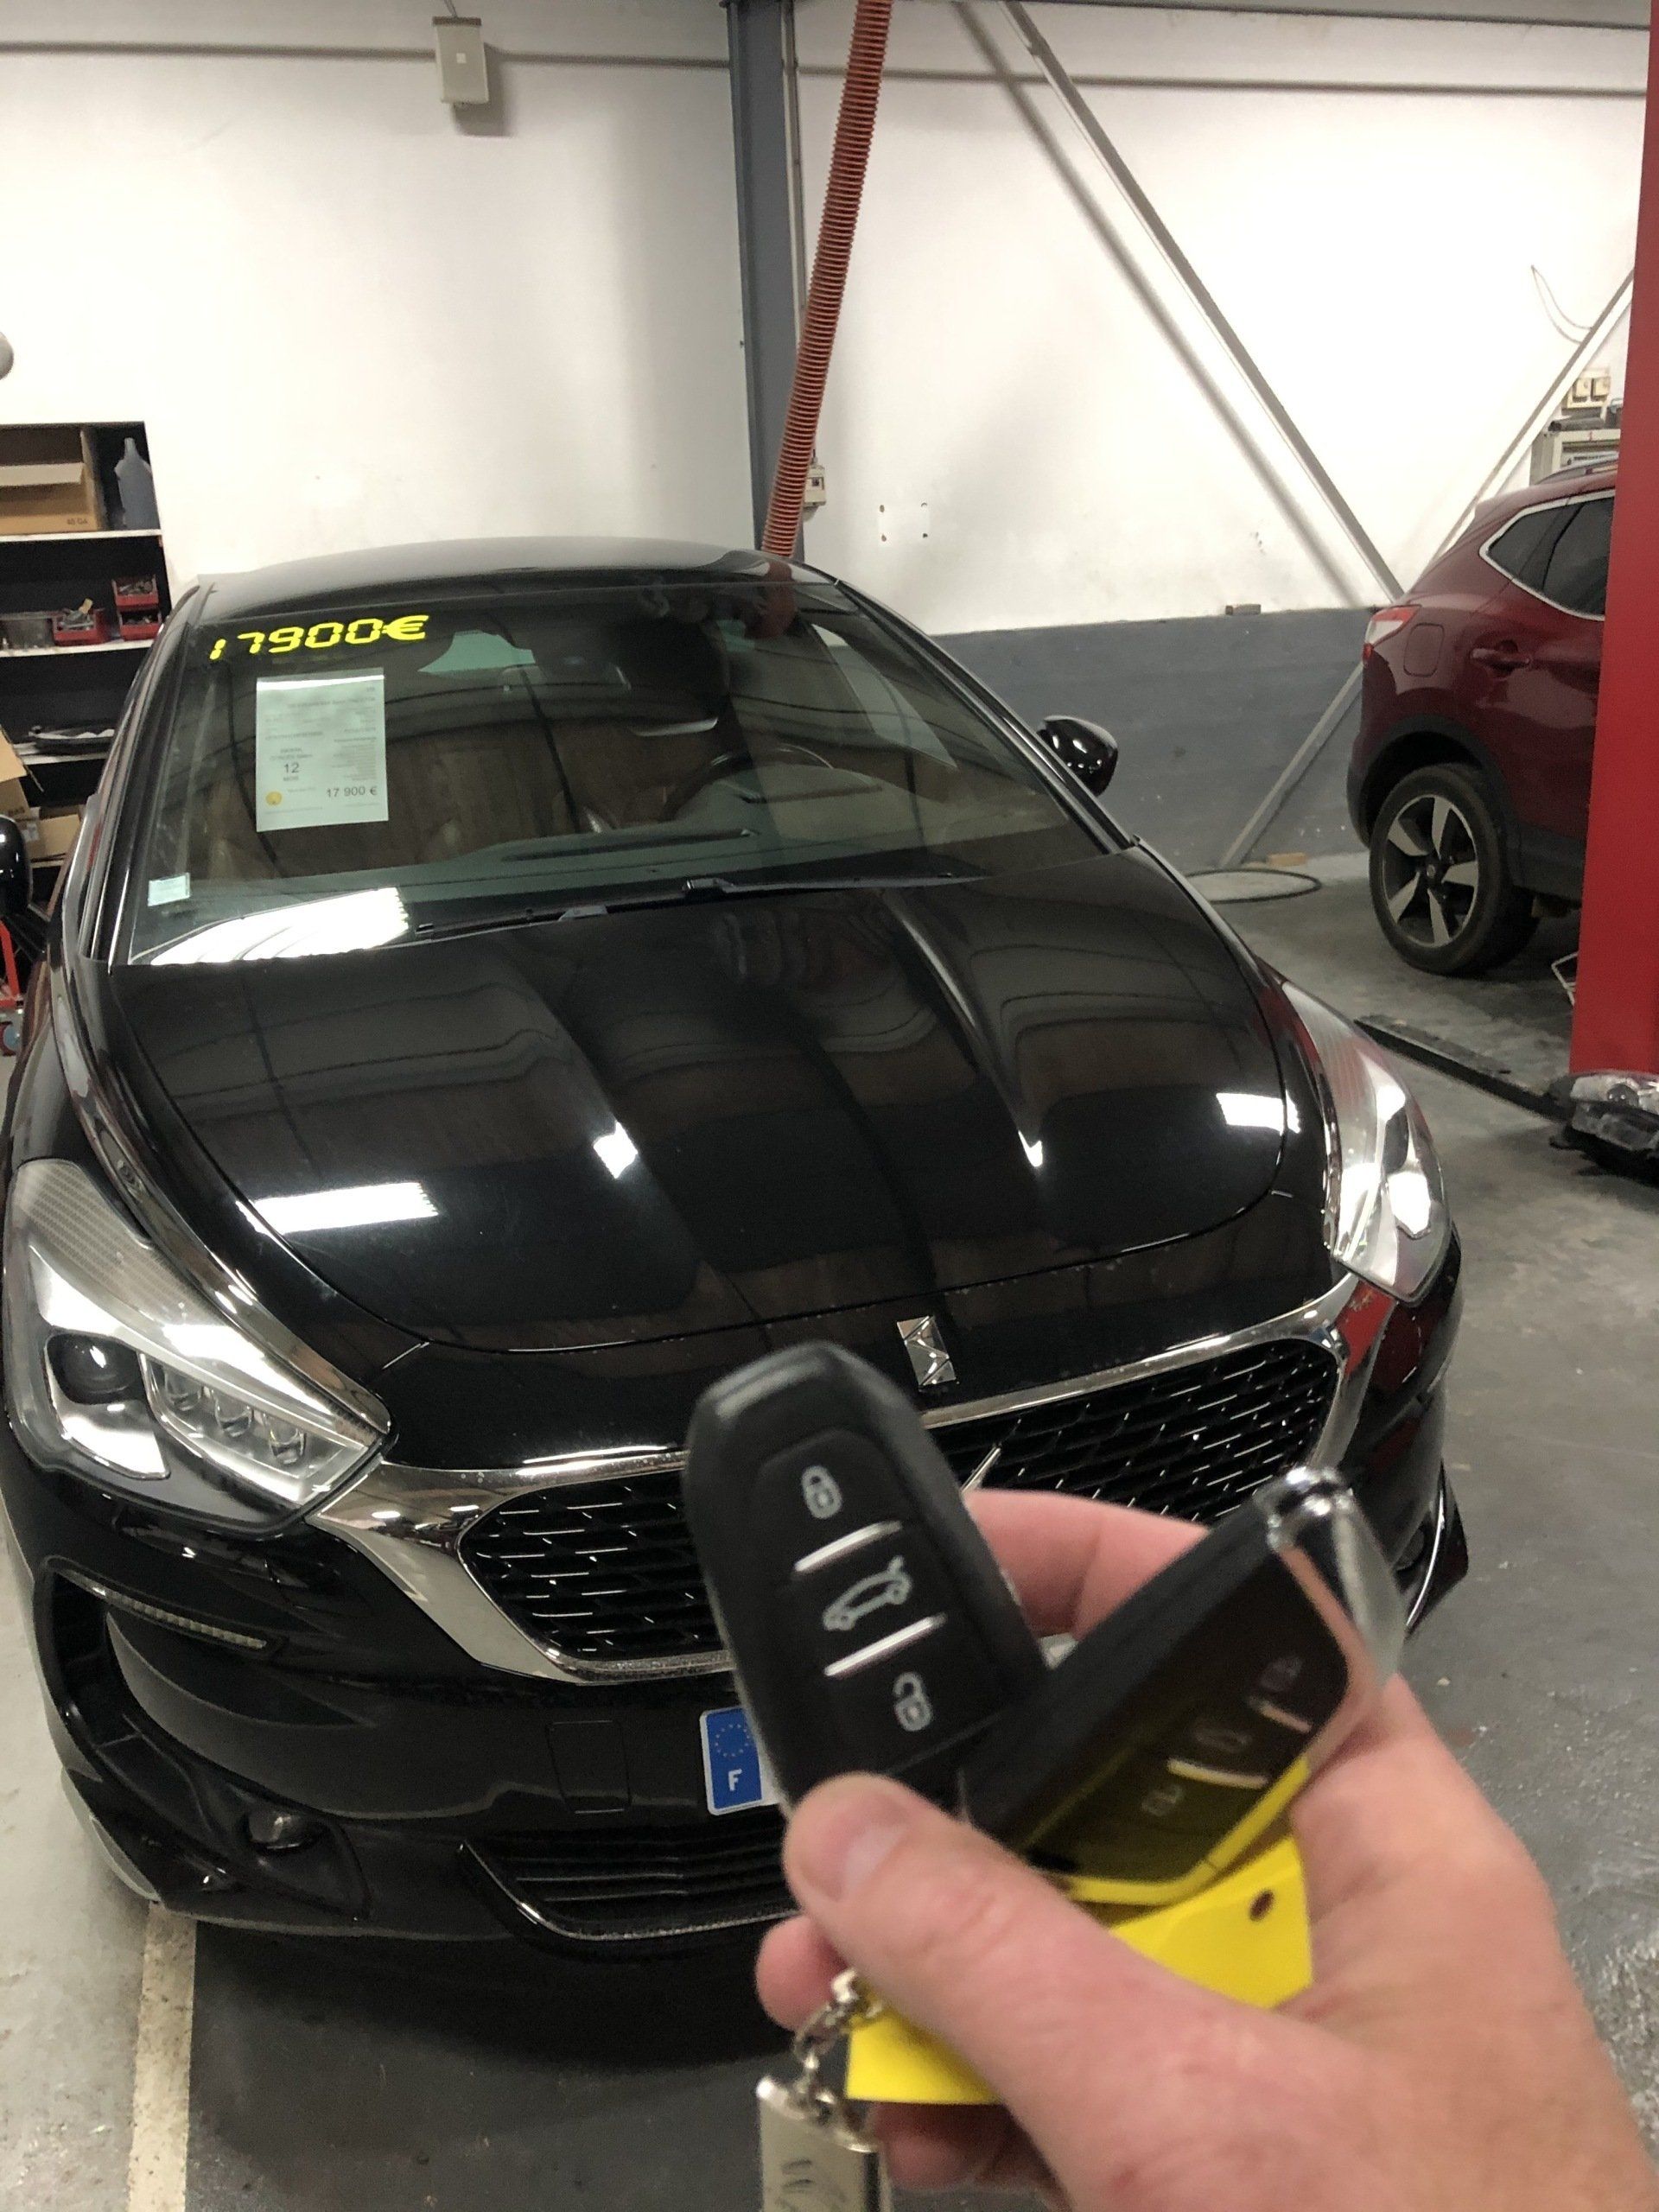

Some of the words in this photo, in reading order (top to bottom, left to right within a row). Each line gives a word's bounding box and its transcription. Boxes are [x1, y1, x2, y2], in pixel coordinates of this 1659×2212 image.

[209, 614, 429, 660] 17900€
[283, 762, 300, 773] 12
[327, 787, 340, 798] 17
[343, 785, 365, 797] 900
[369, 785, 378, 796] €
[728, 1769, 742, 1791] F
